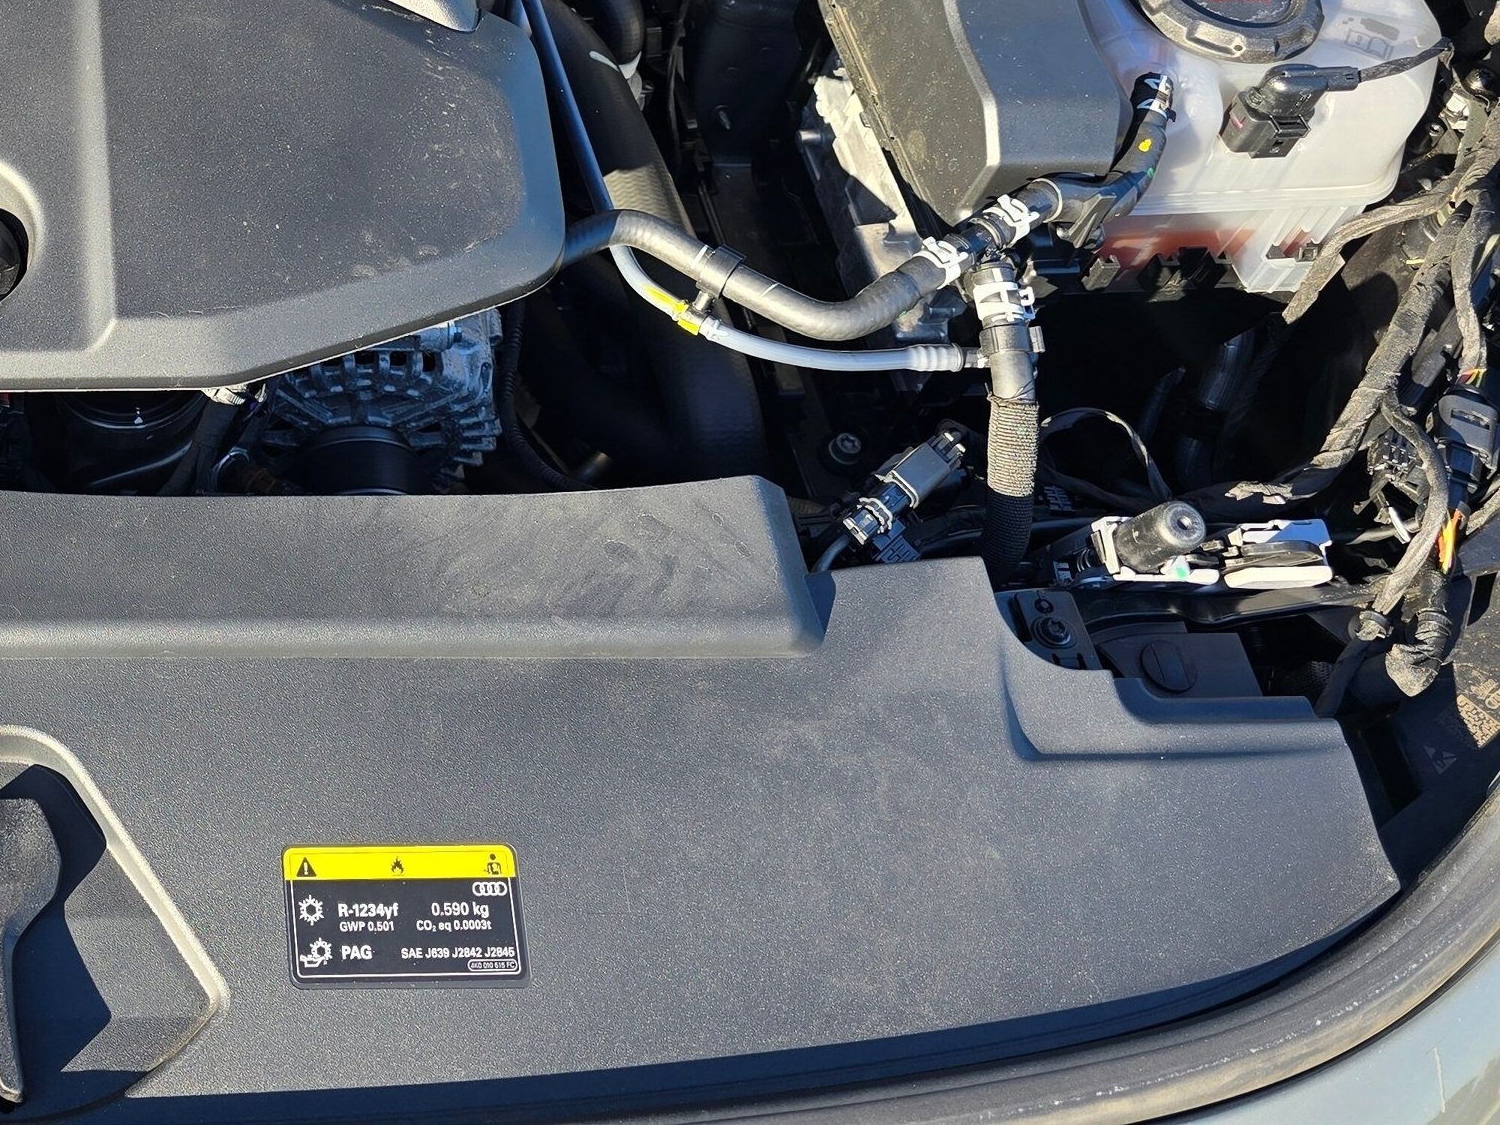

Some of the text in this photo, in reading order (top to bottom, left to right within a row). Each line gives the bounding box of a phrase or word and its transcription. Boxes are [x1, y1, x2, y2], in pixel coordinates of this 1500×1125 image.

[338, 903, 399, 920] R-1234yf
[431, 901, 490, 919] 0.590 kg
[340, 920, 395, 932] GWP 0.501
[438, 921, 452, 932] eq
[454, 920, 493, 930] 0.0003t
[341, 945, 373, 960] PAG
[401, 947, 516, 959] SAE J639 J2842 J2845
